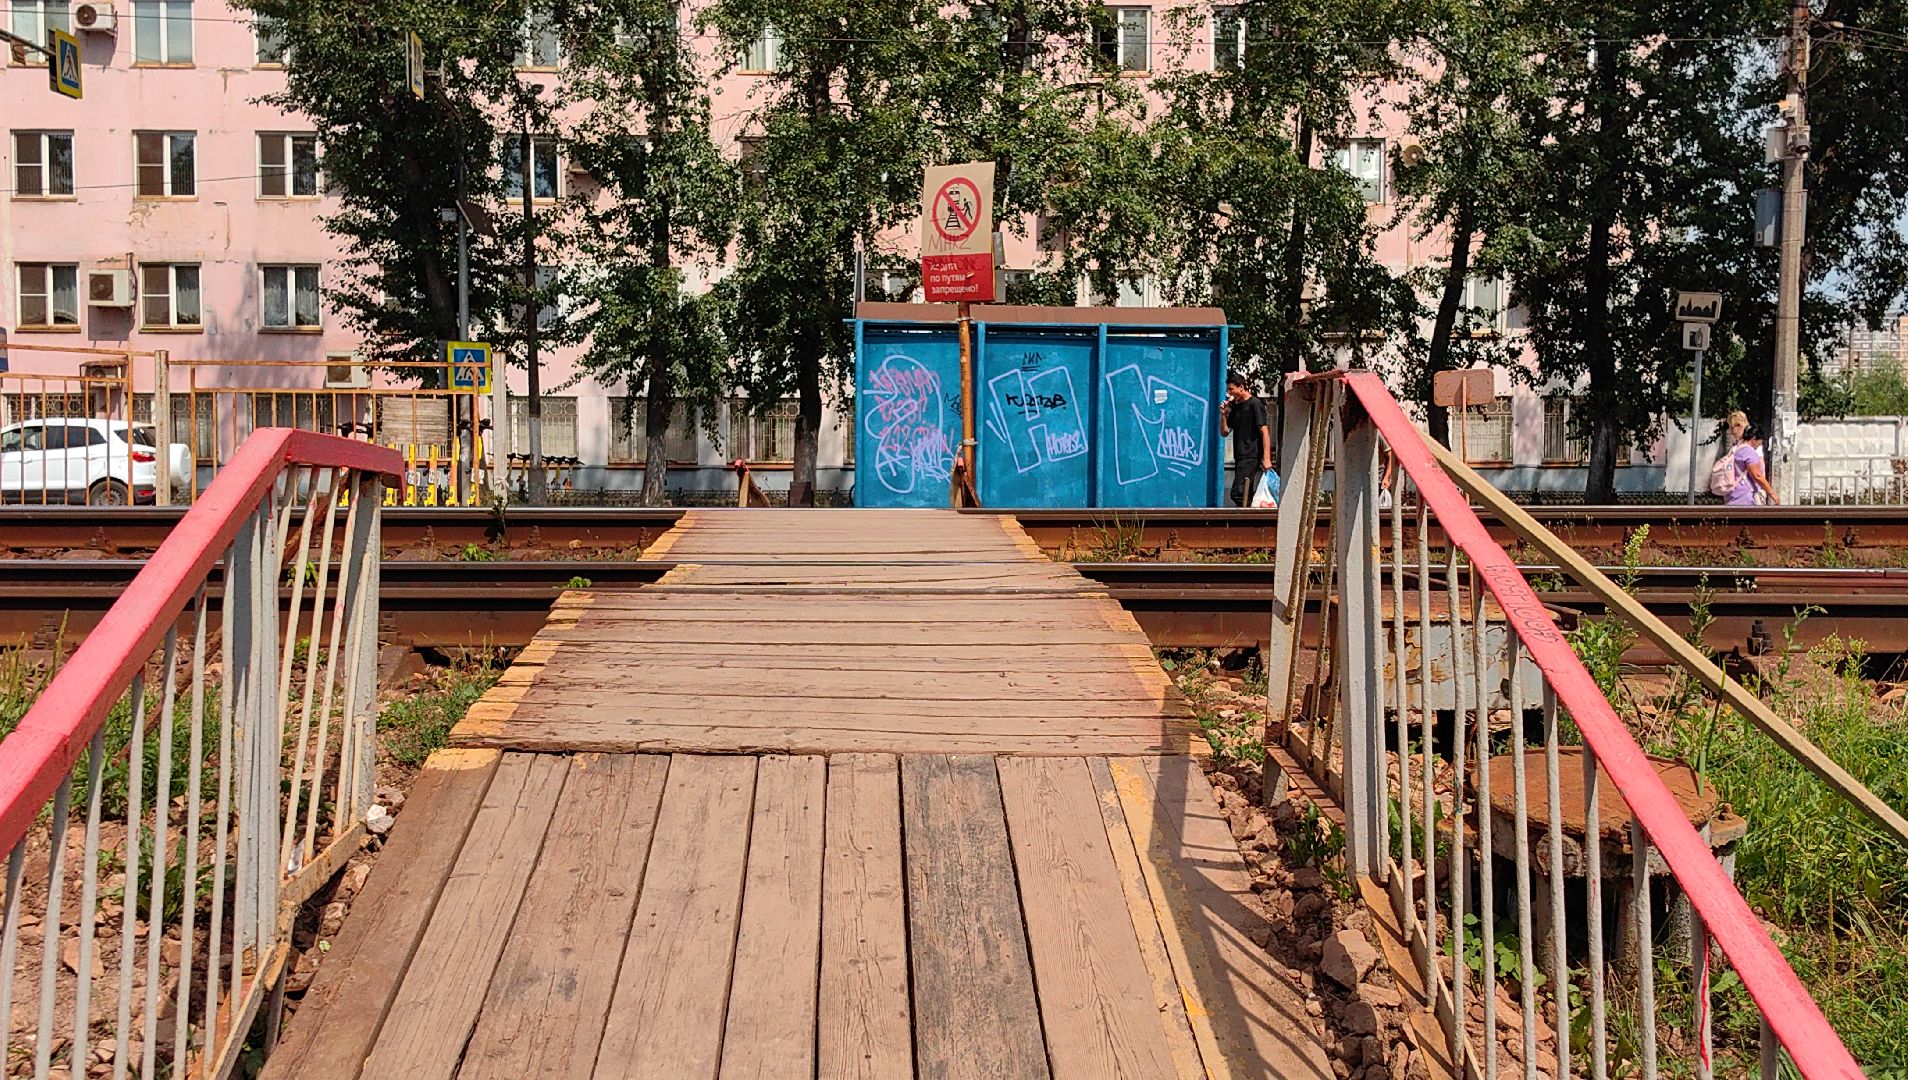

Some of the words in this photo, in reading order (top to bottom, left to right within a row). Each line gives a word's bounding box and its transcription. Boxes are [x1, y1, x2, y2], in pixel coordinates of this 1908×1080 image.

[930, 275, 941, 283] по
[942, 274, 966, 285] путям
[931, 284, 979, 296] запрещено!
